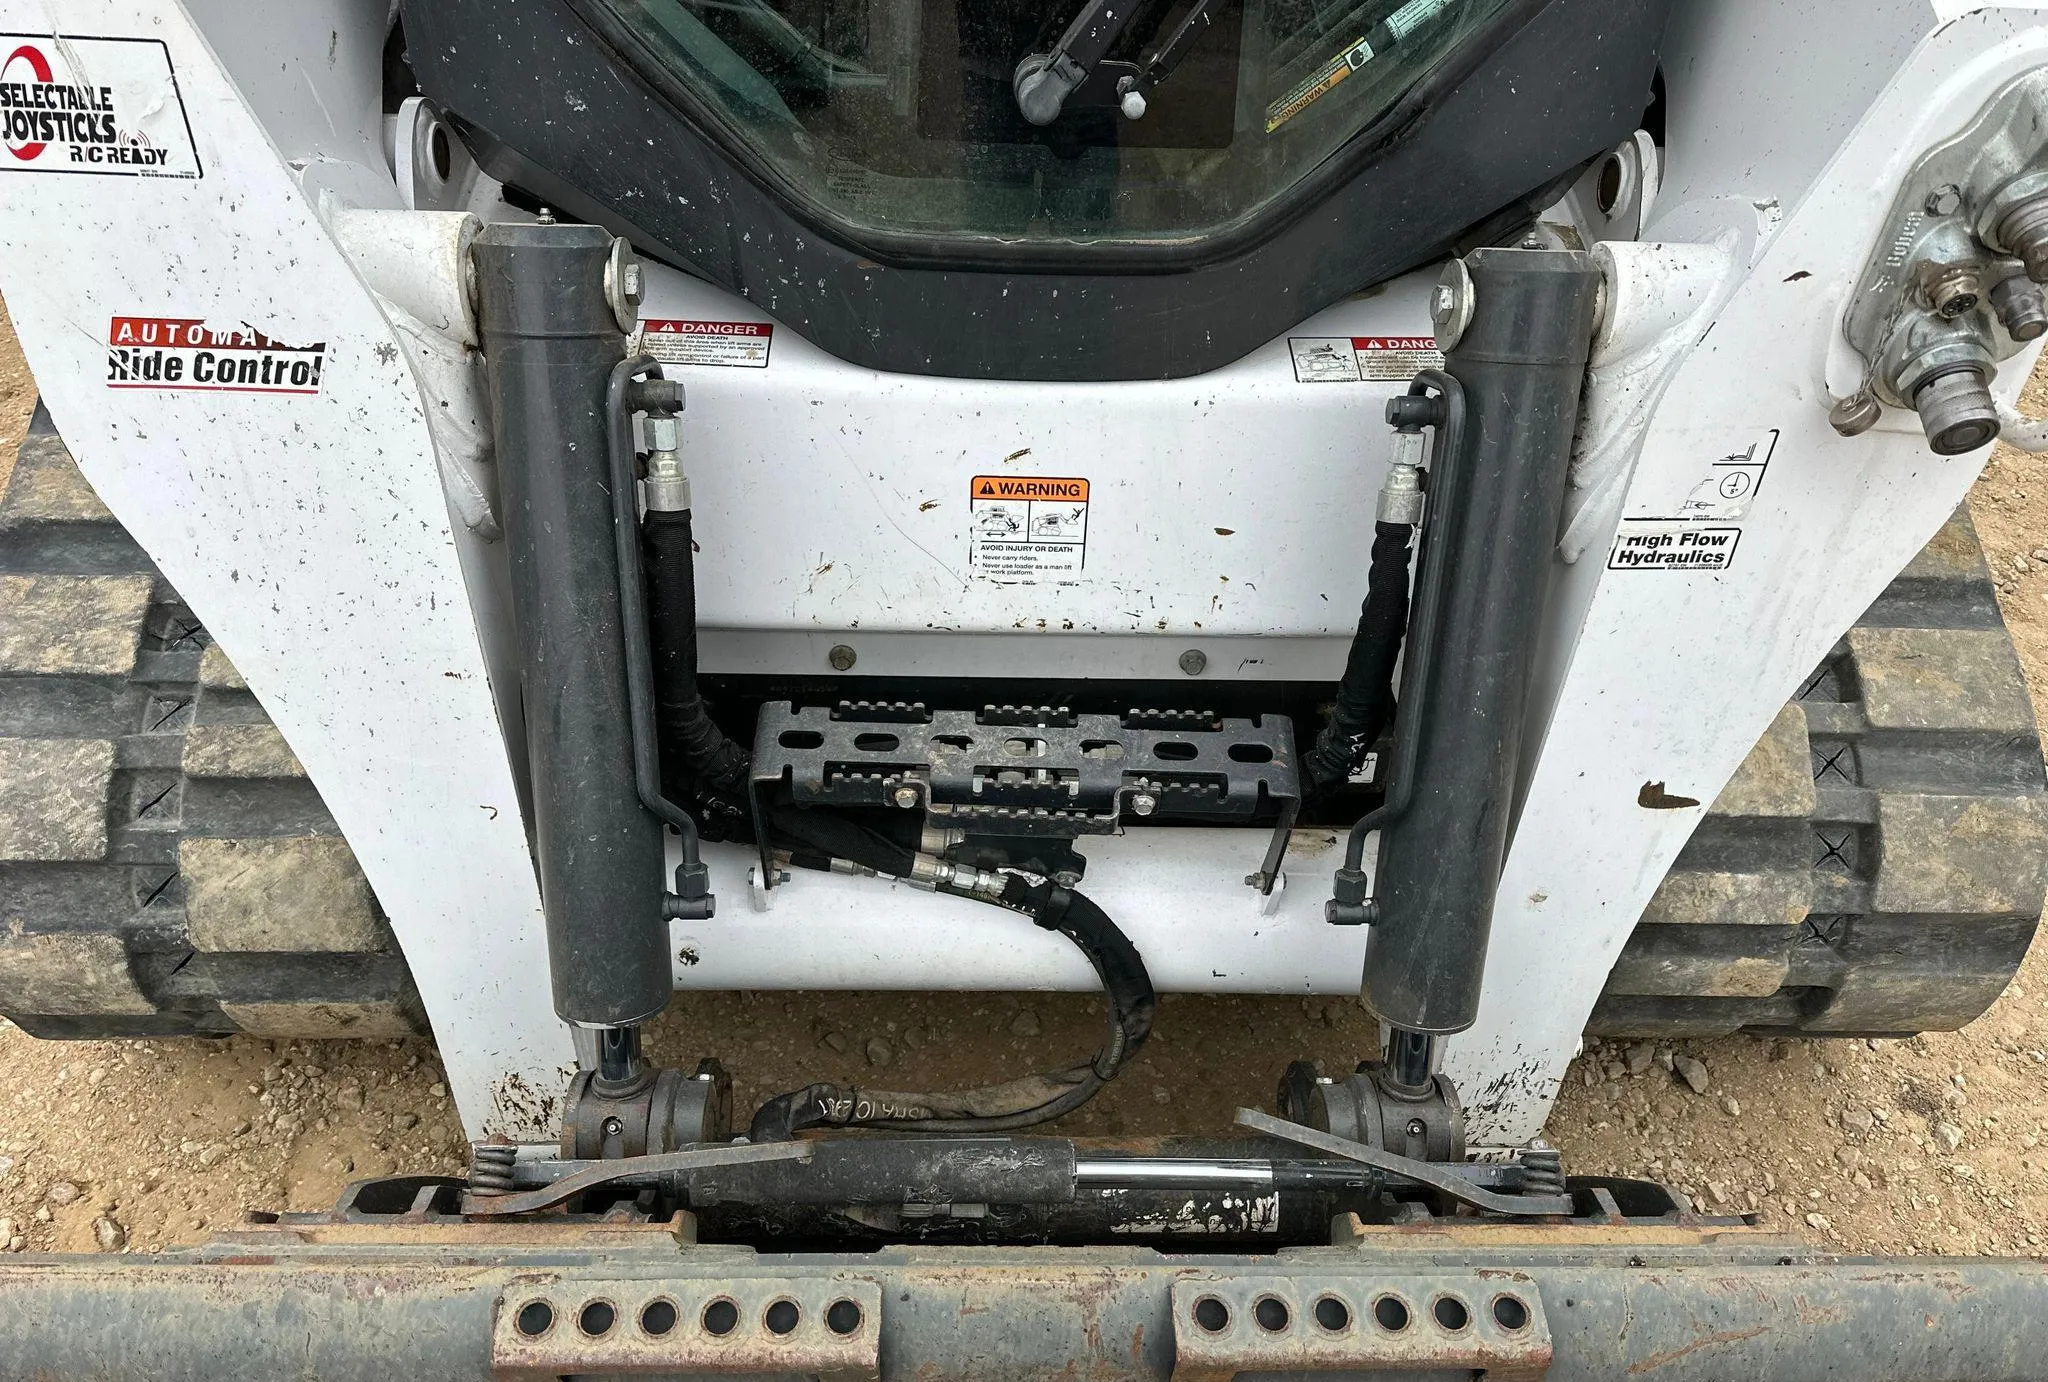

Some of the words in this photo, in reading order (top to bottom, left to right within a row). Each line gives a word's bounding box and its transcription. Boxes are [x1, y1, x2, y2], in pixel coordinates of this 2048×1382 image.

[1281, 86, 1324, 121] WARNING
[3, 110, 117, 144] JOYSTICKS
[682, 323, 757, 335] DANGER
[1387, 339, 1437, 349] DANG
[108, 348, 183, 382] Ride
[193, 352, 323, 386] Control
[998, 482, 1081, 496] WARNING
[1679, 533, 1729, 546] Flow
[1618, 550, 1725, 566] Hydraulics
